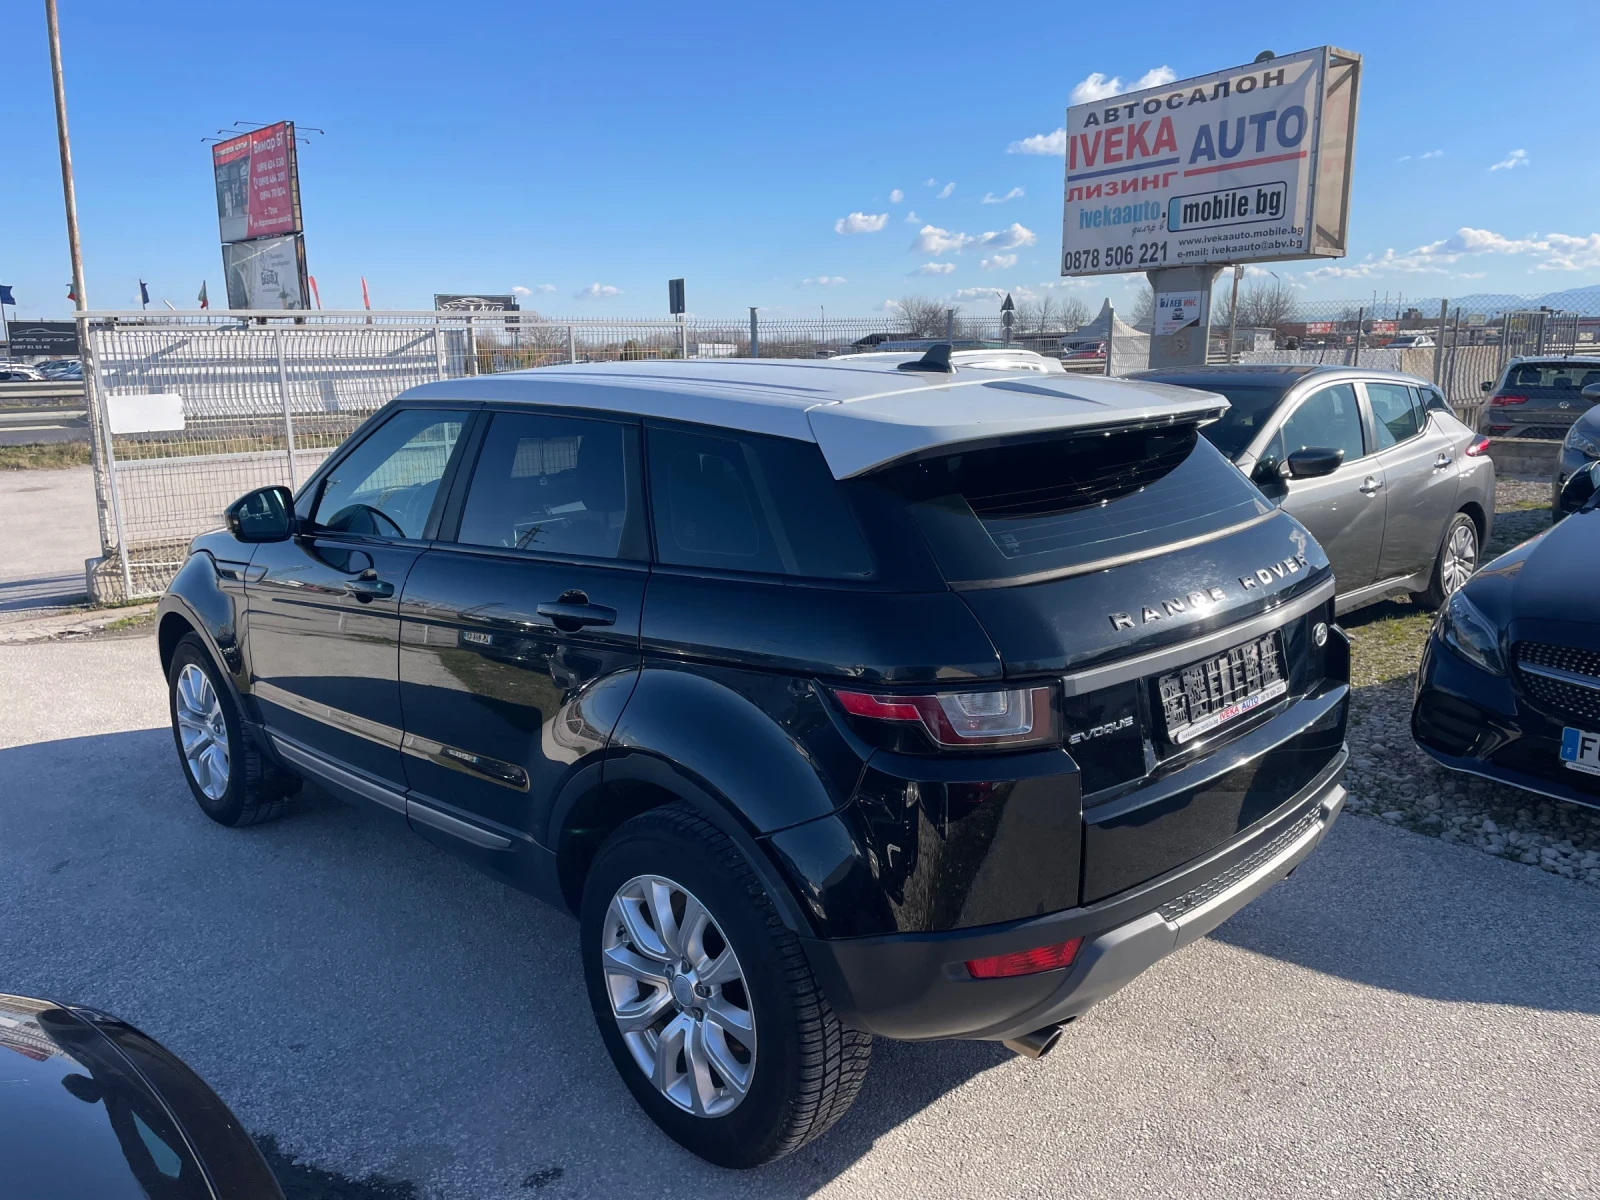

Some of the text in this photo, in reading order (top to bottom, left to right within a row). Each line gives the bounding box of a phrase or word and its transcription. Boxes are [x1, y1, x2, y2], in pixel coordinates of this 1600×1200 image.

[1083, 68, 1285, 128] АВТОСАЛОН
[1069, 105, 1309, 171] IVEKA AUTO
[1066, 171, 1179, 202] ЛИЗИНГ
[1182, 188, 1282, 224] mobile.bg
[1177, 238, 1303, 259] e-mail: ivekaauto@abv.bg
[1178, 226, 1304, 246] www.ivekaauto.mobile.bg
[1064, 240, 1168, 271] 0878 506 221
[1108, 553, 1310, 631] RANGE ROVER
[1219, 704, 1240, 721] IVEKA
[1241, 695, 1259, 709] AUTO
[1069, 715, 1134, 745] EVOQUE
[1580, 736, 1600, 761] F
